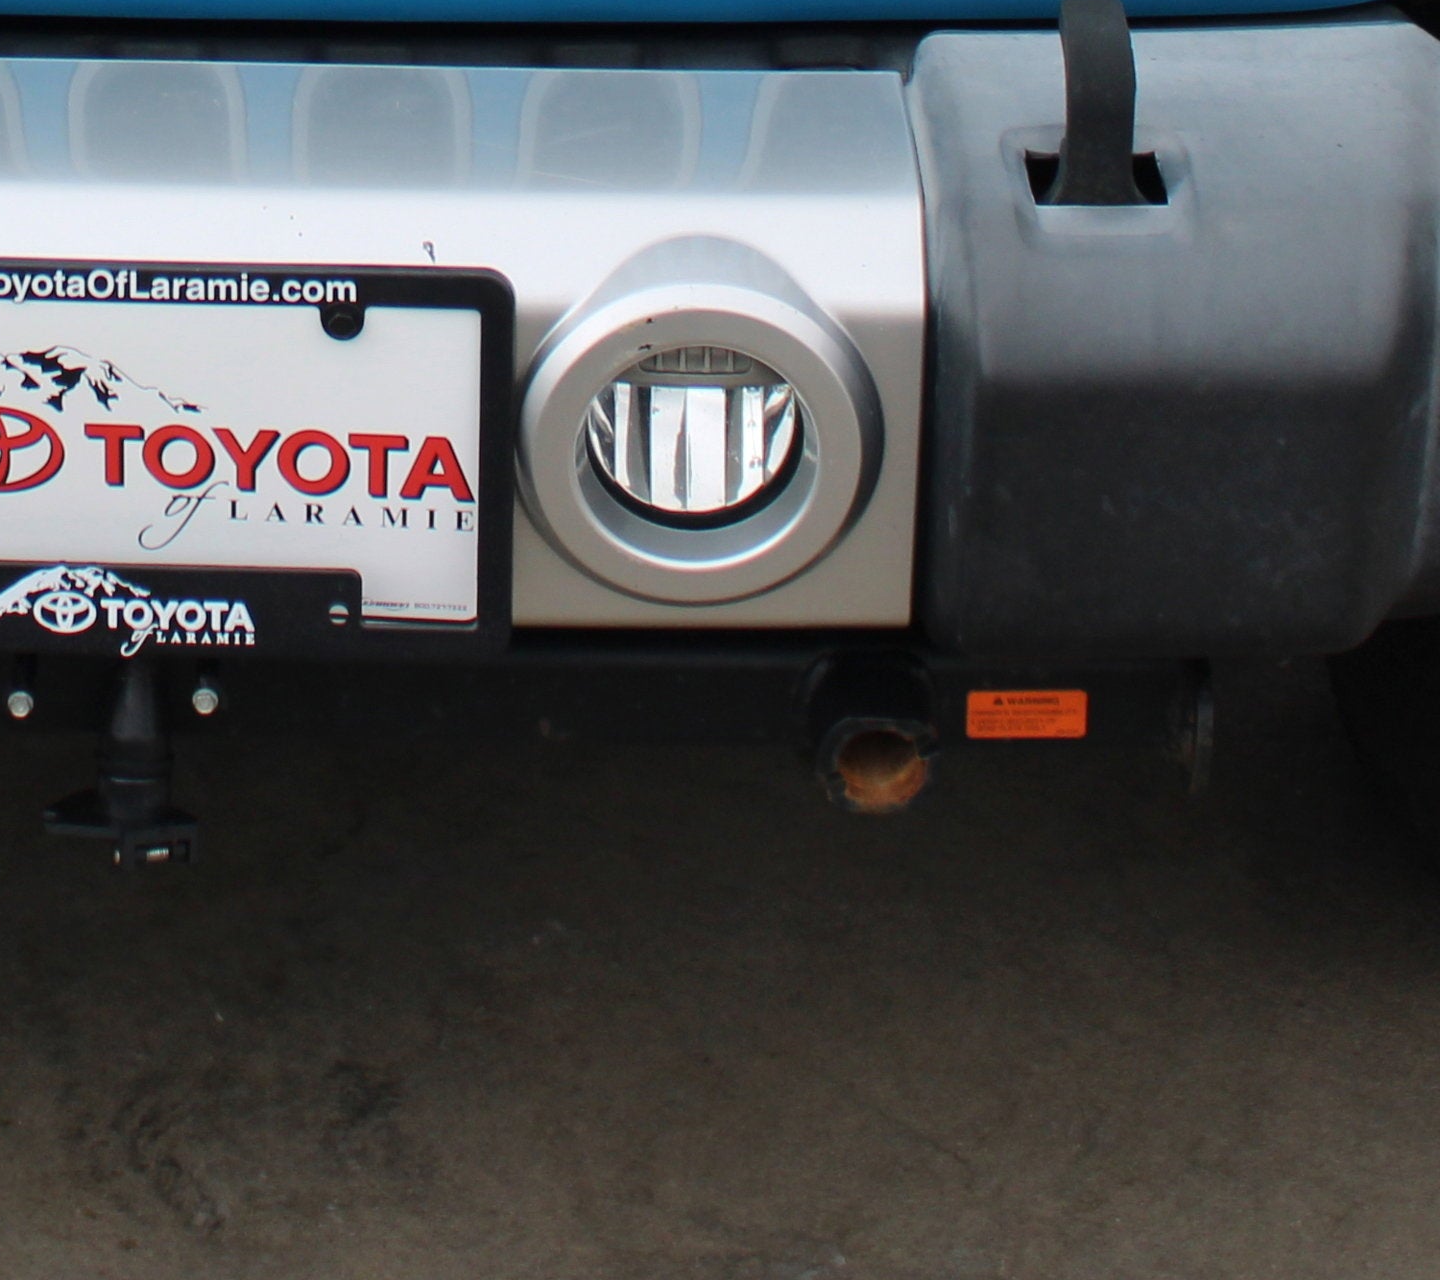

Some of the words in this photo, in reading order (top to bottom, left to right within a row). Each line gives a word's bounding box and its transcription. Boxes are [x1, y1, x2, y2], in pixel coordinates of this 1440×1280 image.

[83, 424, 476, 503] TOYOTA
[138, 481, 229, 550] of
[228, 499, 474, 532] LARAMIE
[100, 598, 256, 632] TOYOTA
[120, 623, 158, 657] of
[156, 631, 256, 646] LARAMIE
